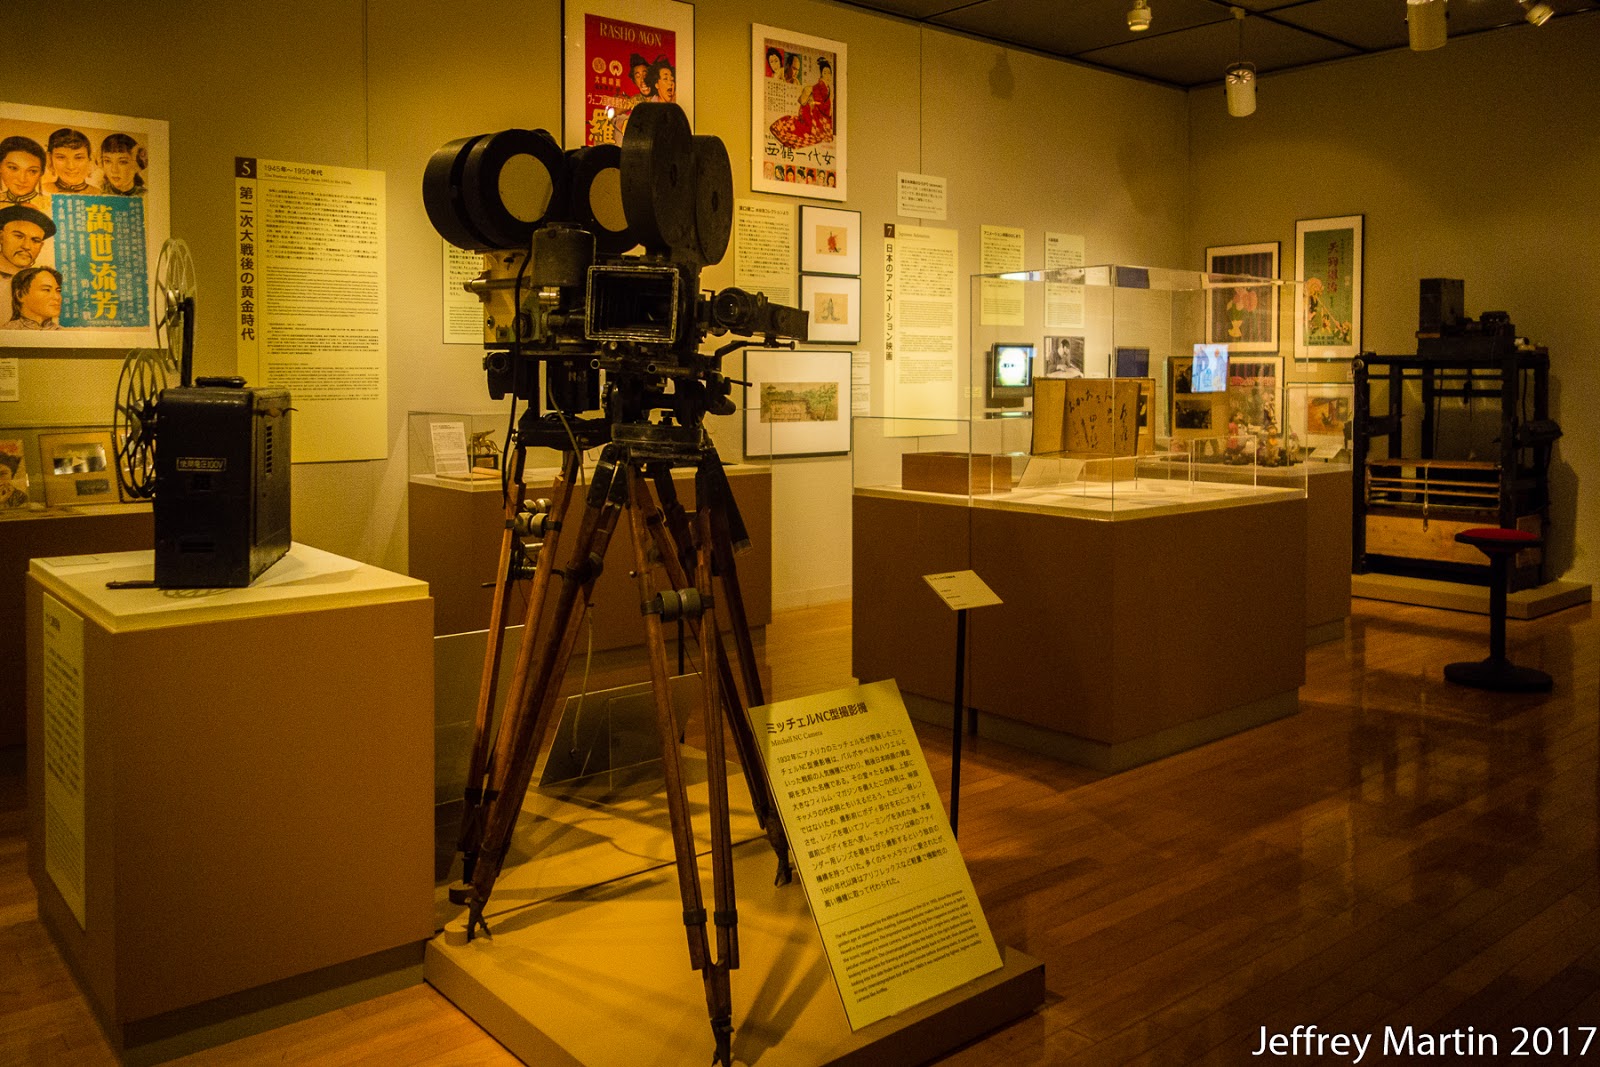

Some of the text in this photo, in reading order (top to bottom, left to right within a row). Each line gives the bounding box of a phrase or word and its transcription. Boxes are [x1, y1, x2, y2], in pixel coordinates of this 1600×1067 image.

[600, 22, 662, 46] RASHO MON
[241, 161, 251, 176] 5
[887, 226, 893, 236] 7
[86, 204, 119, 319] 萬世流芳
[239, 186, 255, 341] 第二次大戦後の黄金時代
[885, 243, 894, 361] 日本のアニメーション映画
[764, 701, 868, 734] ミッチェルNC型撮影機
[770, 729, 823, 746] Mitchell NC Camera
